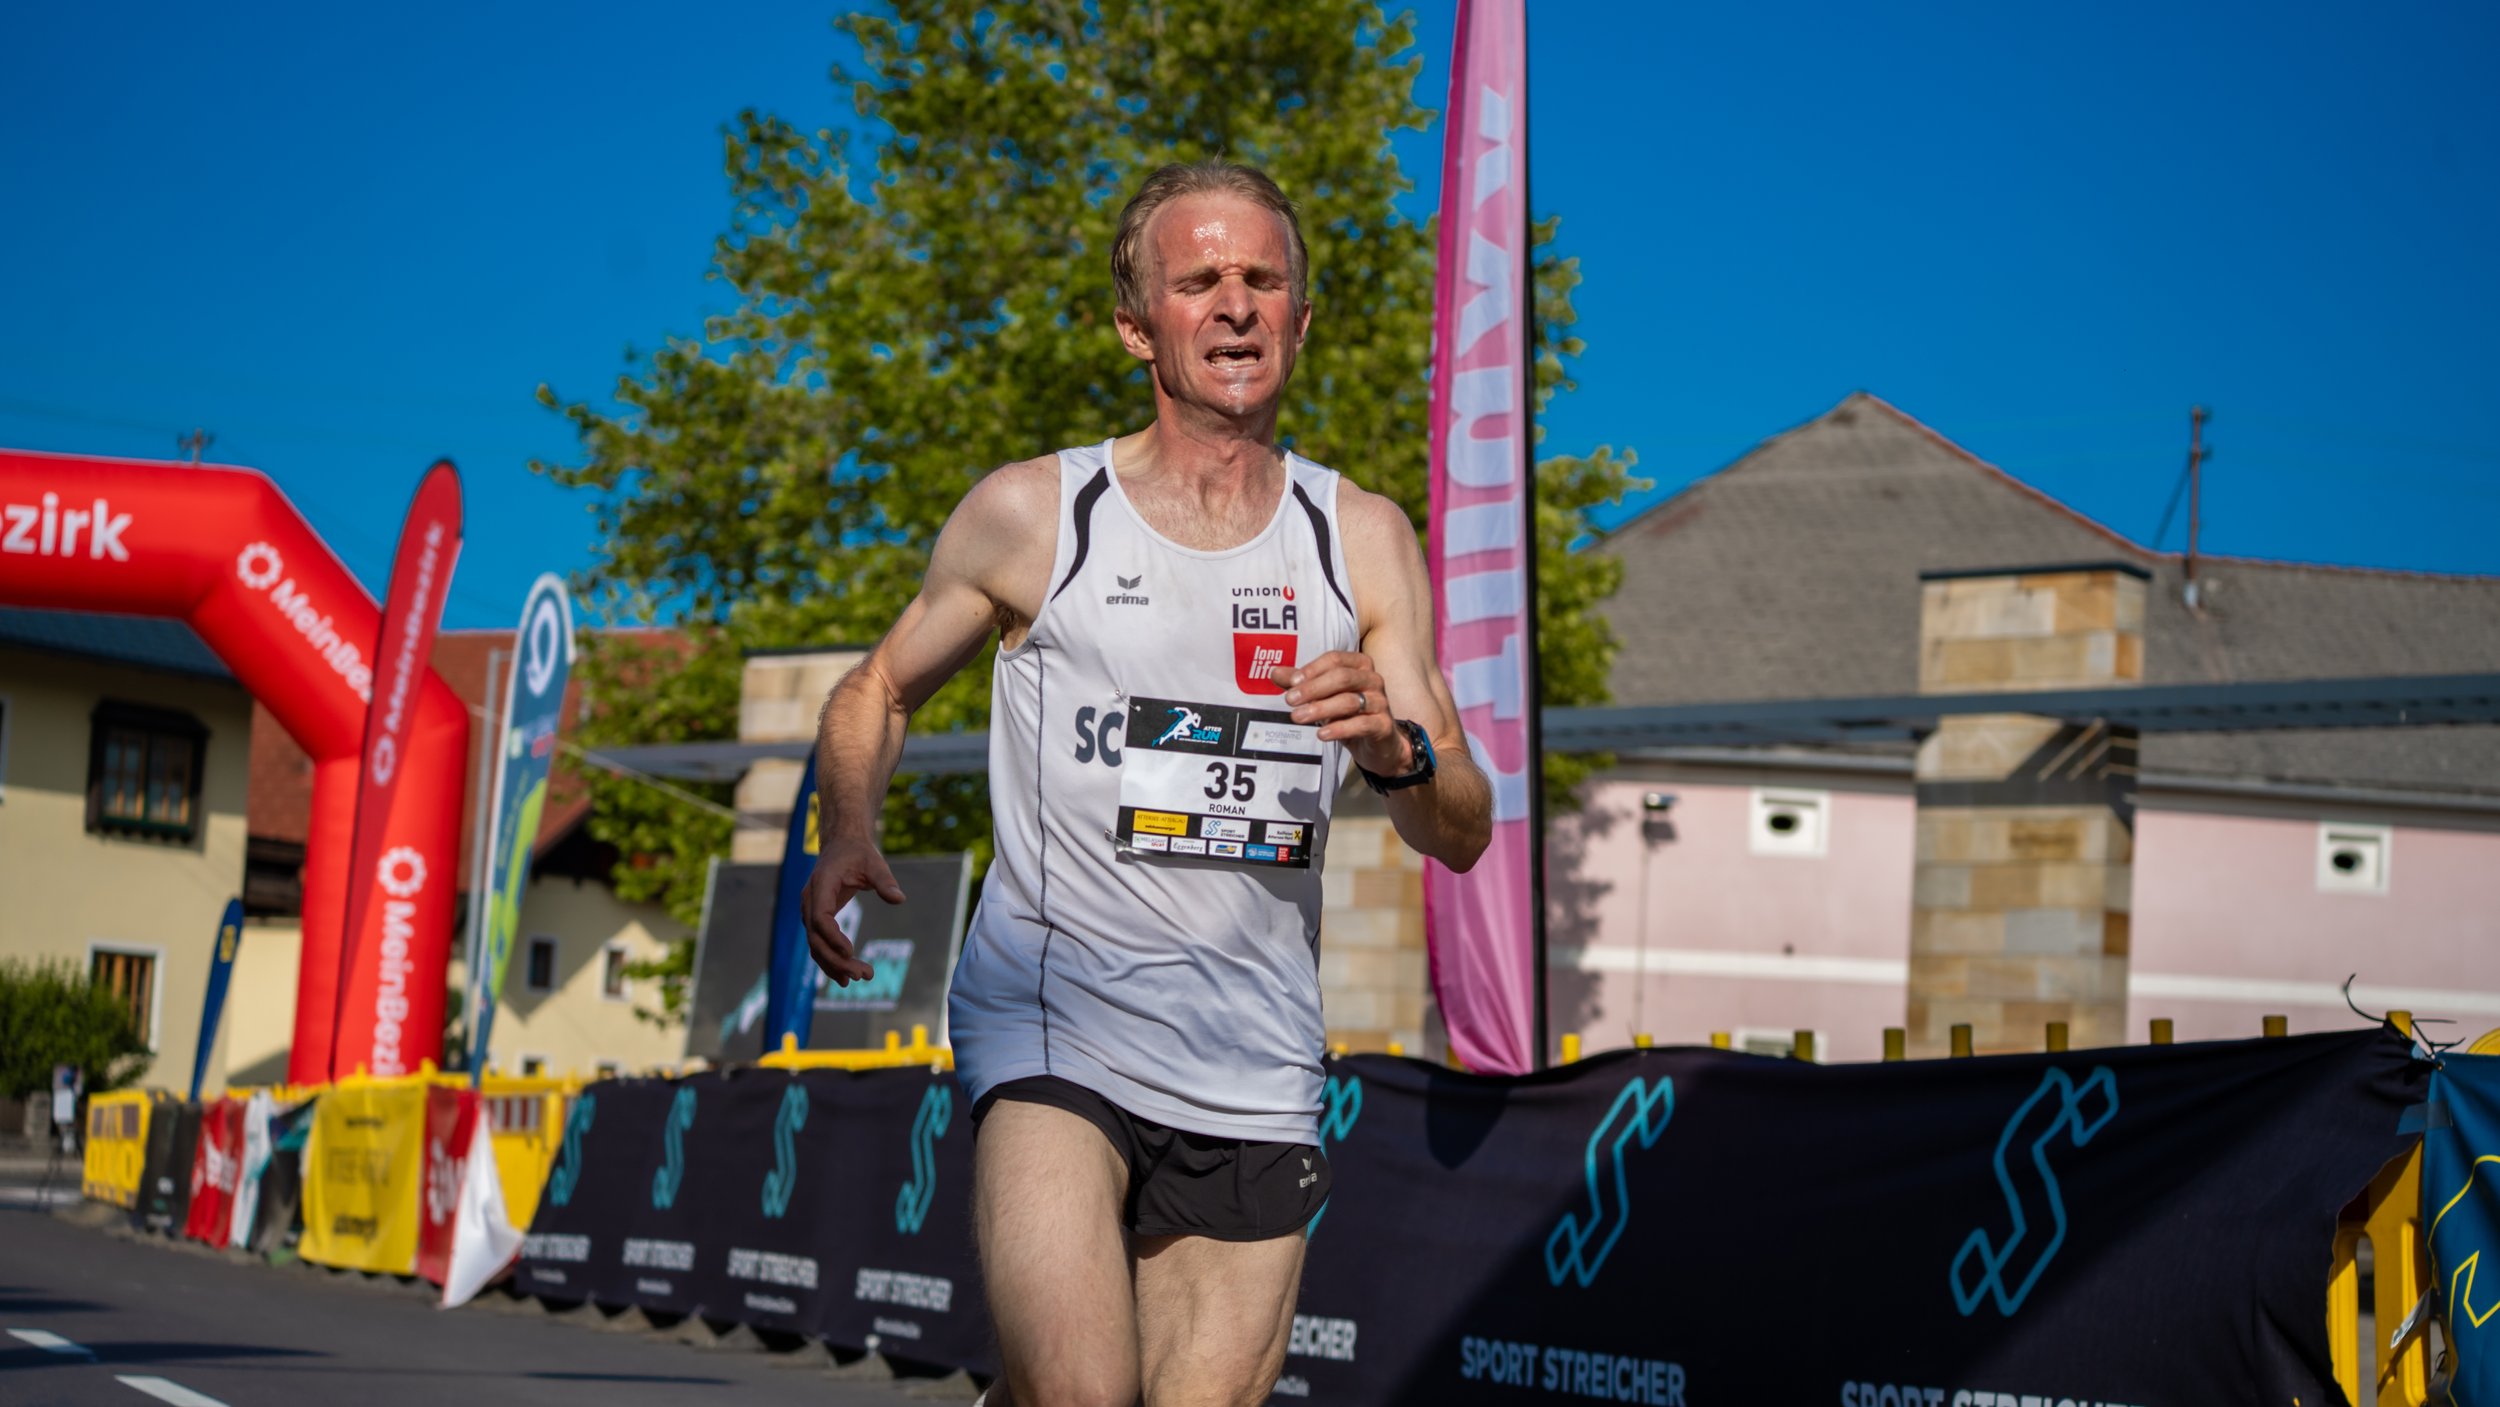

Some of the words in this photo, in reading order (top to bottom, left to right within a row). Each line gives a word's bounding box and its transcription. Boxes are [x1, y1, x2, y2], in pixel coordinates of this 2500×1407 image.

[0, 491, 133, 562] zirk
[1106, 593, 1149, 605] erima
[1232, 603, 1298, 631] IGLA
[1253, 645, 1283, 664] long
[1192, 729, 1221, 741] RUN
[1203, 761, 1257, 802] 35
[1209, 803, 1246, 815] ROMAN
[1461, 1335, 1538, 1389] SPORT
[1542, 1346, 1686, 1407] STREICHER
